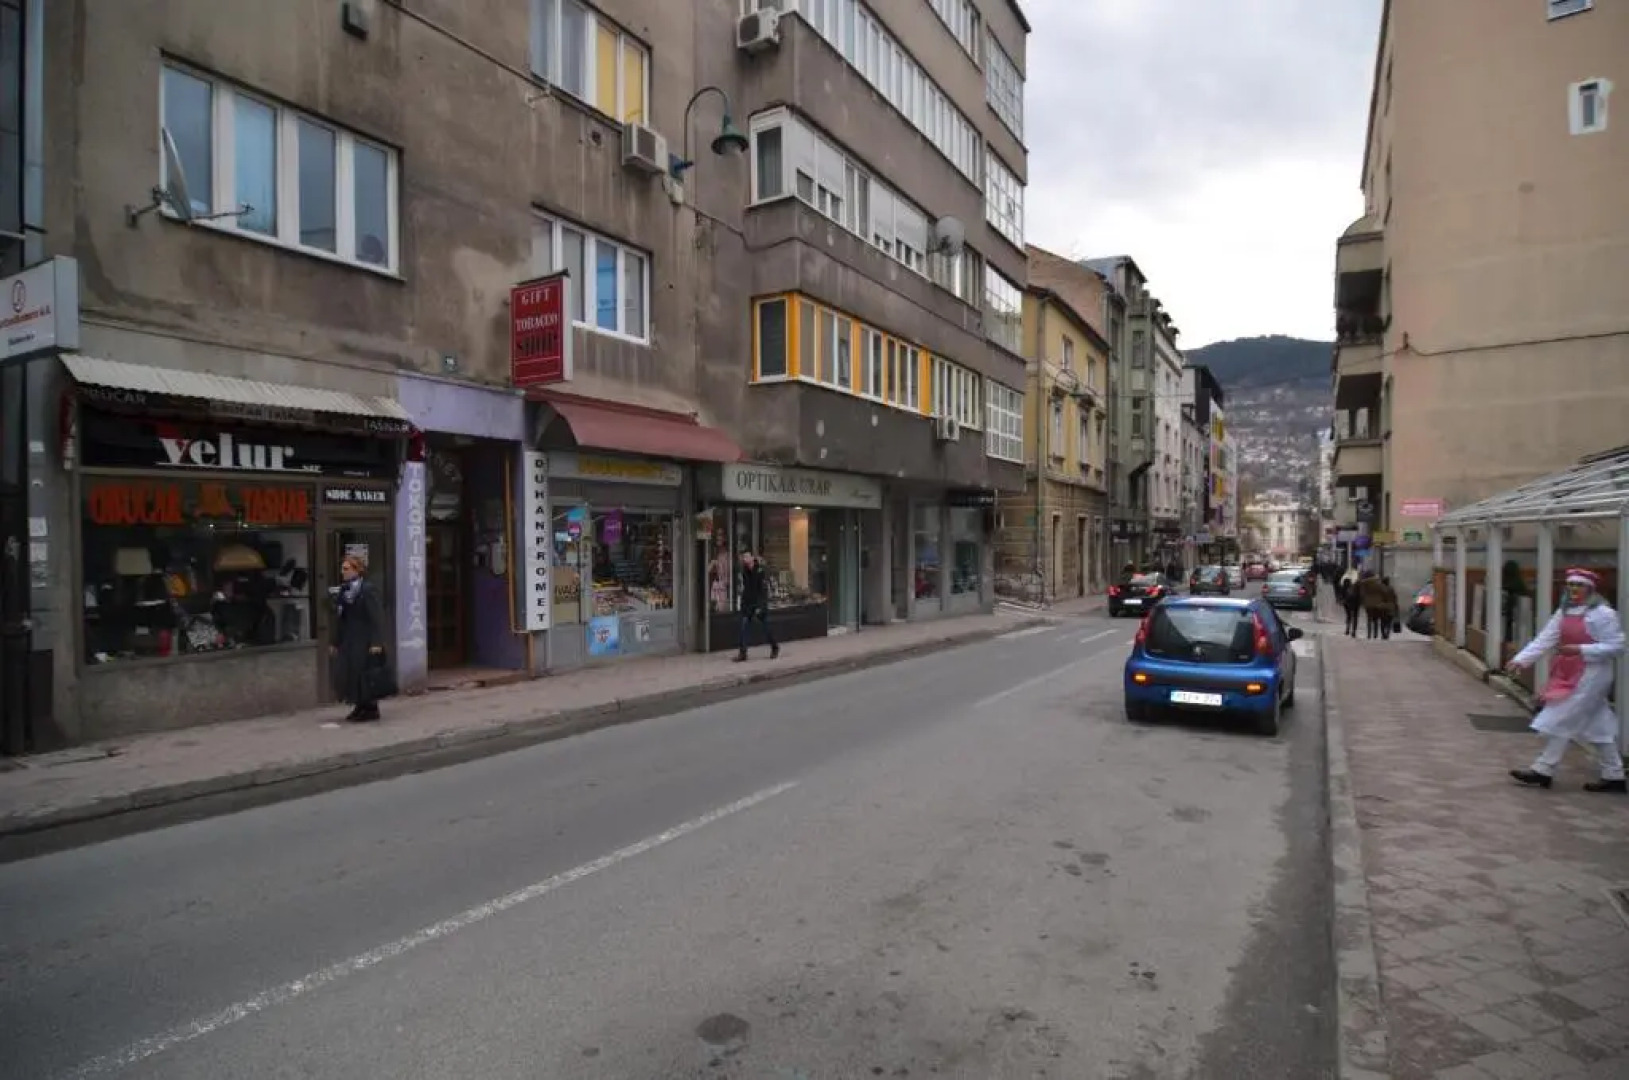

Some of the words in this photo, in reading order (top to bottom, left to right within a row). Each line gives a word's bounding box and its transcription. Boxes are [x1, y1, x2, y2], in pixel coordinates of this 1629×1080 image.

[521, 287, 550, 305] GIFT
[354, 489, 387, 502] MAKER
[535, 458, 547, 623] DUHANPROMET
